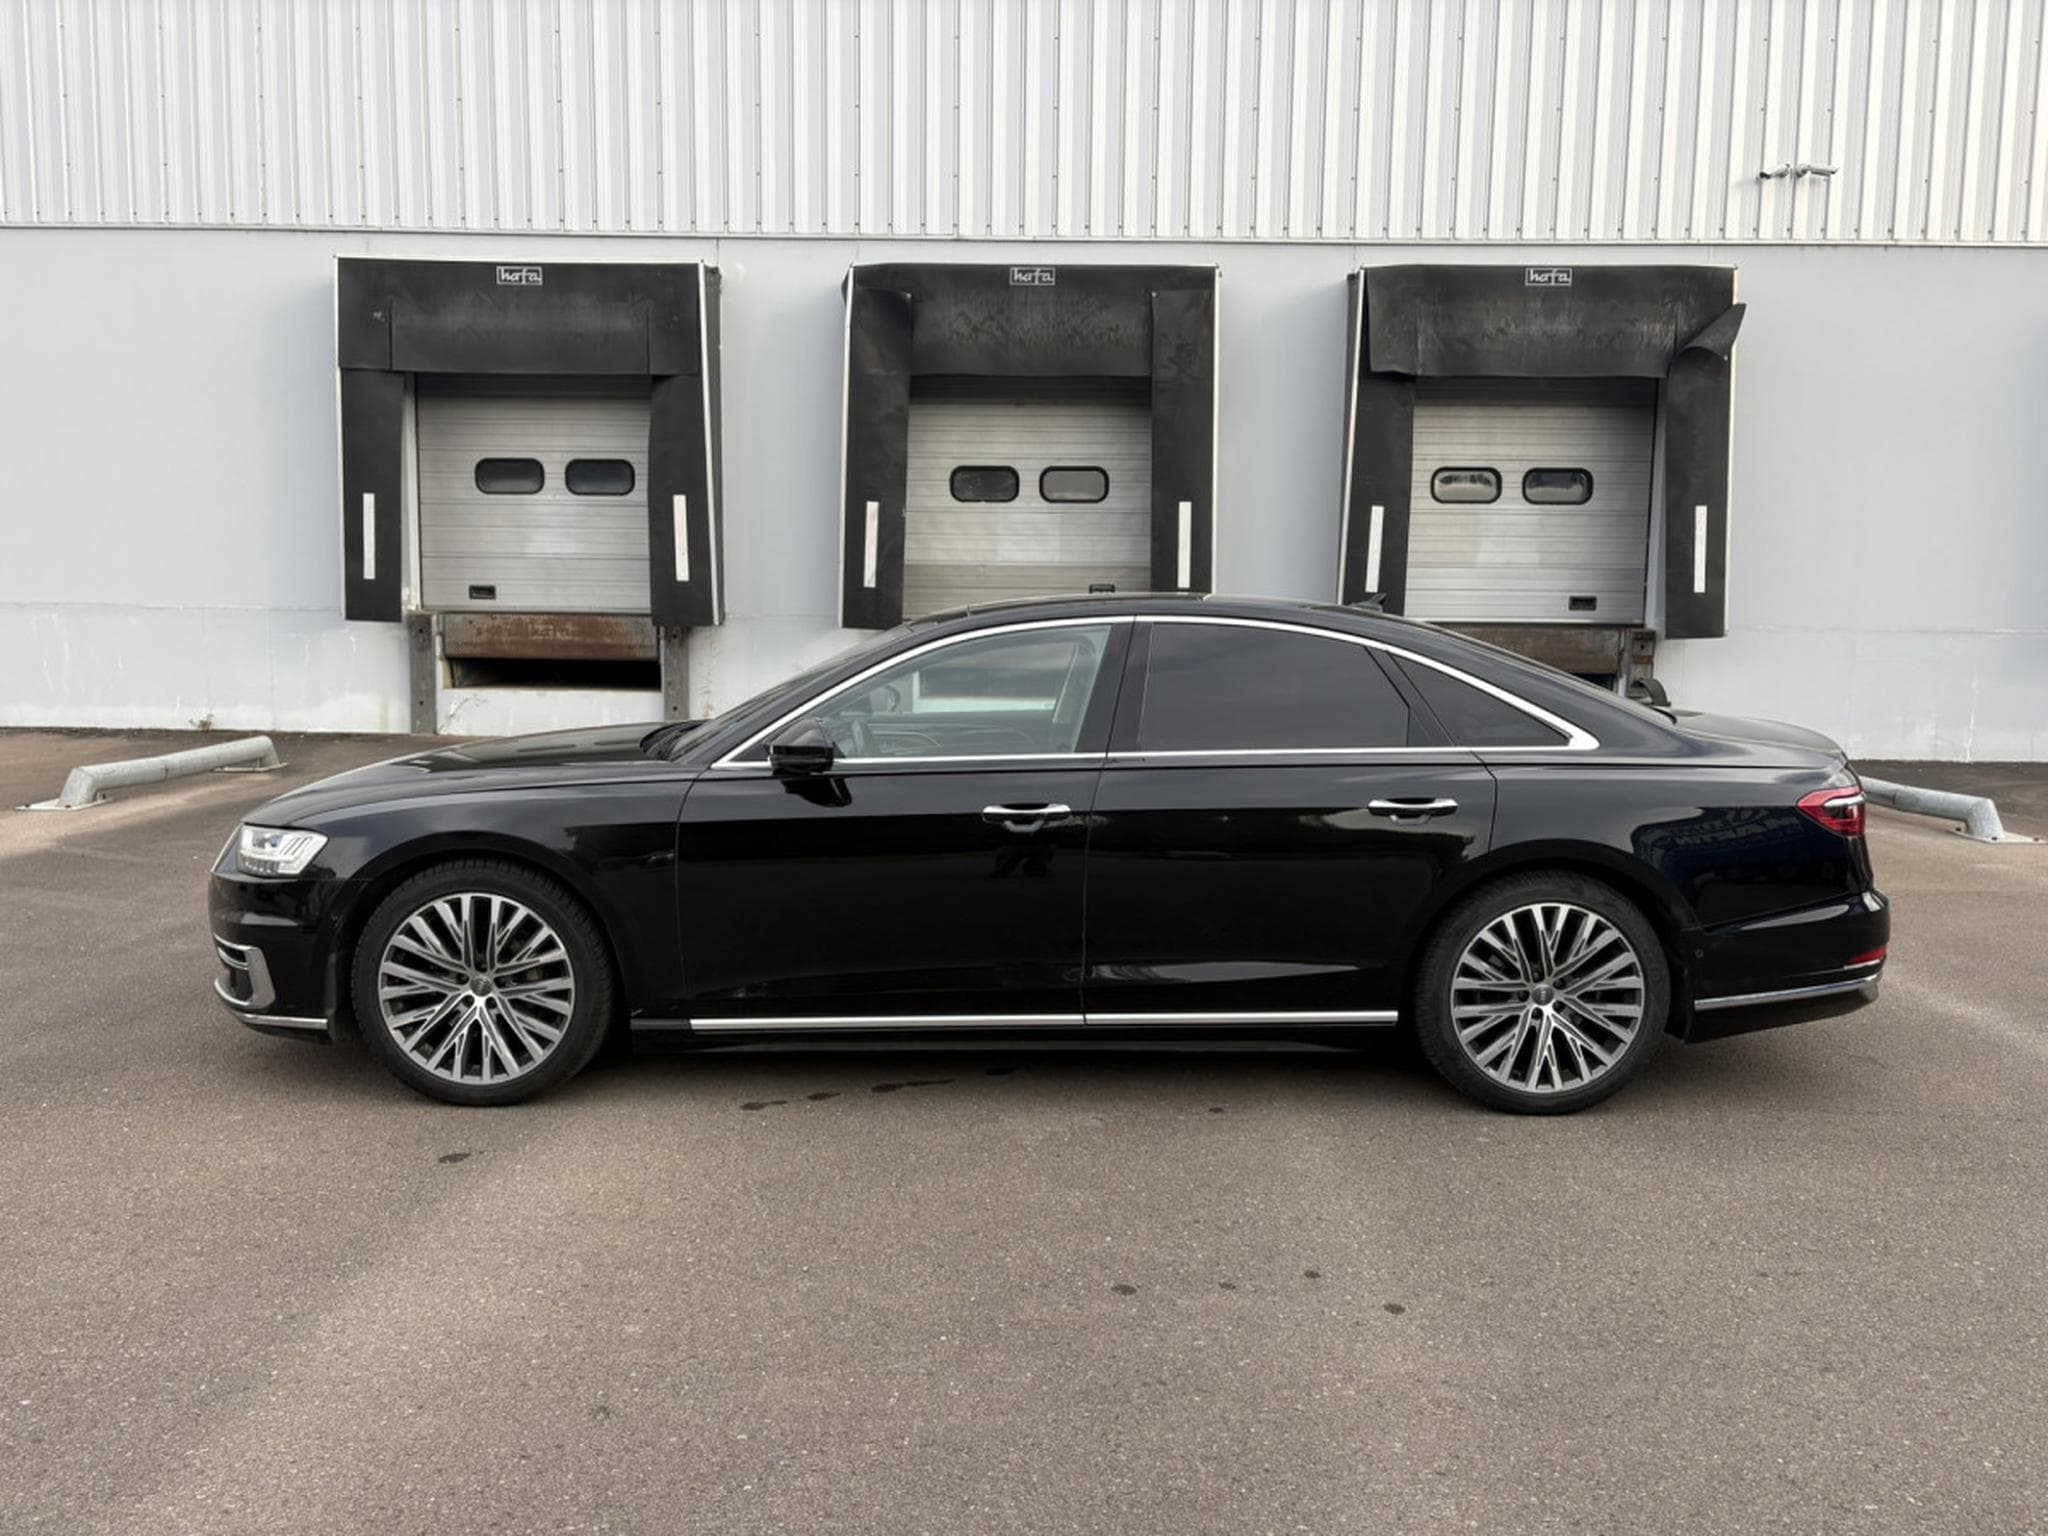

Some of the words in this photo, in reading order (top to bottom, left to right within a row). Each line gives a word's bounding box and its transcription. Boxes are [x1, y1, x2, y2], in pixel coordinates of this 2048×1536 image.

[500, 267, 542, 285] hafa
[1013, 267, 1054, 285] hafa
[1529, 268, 1571, 286] hafa
